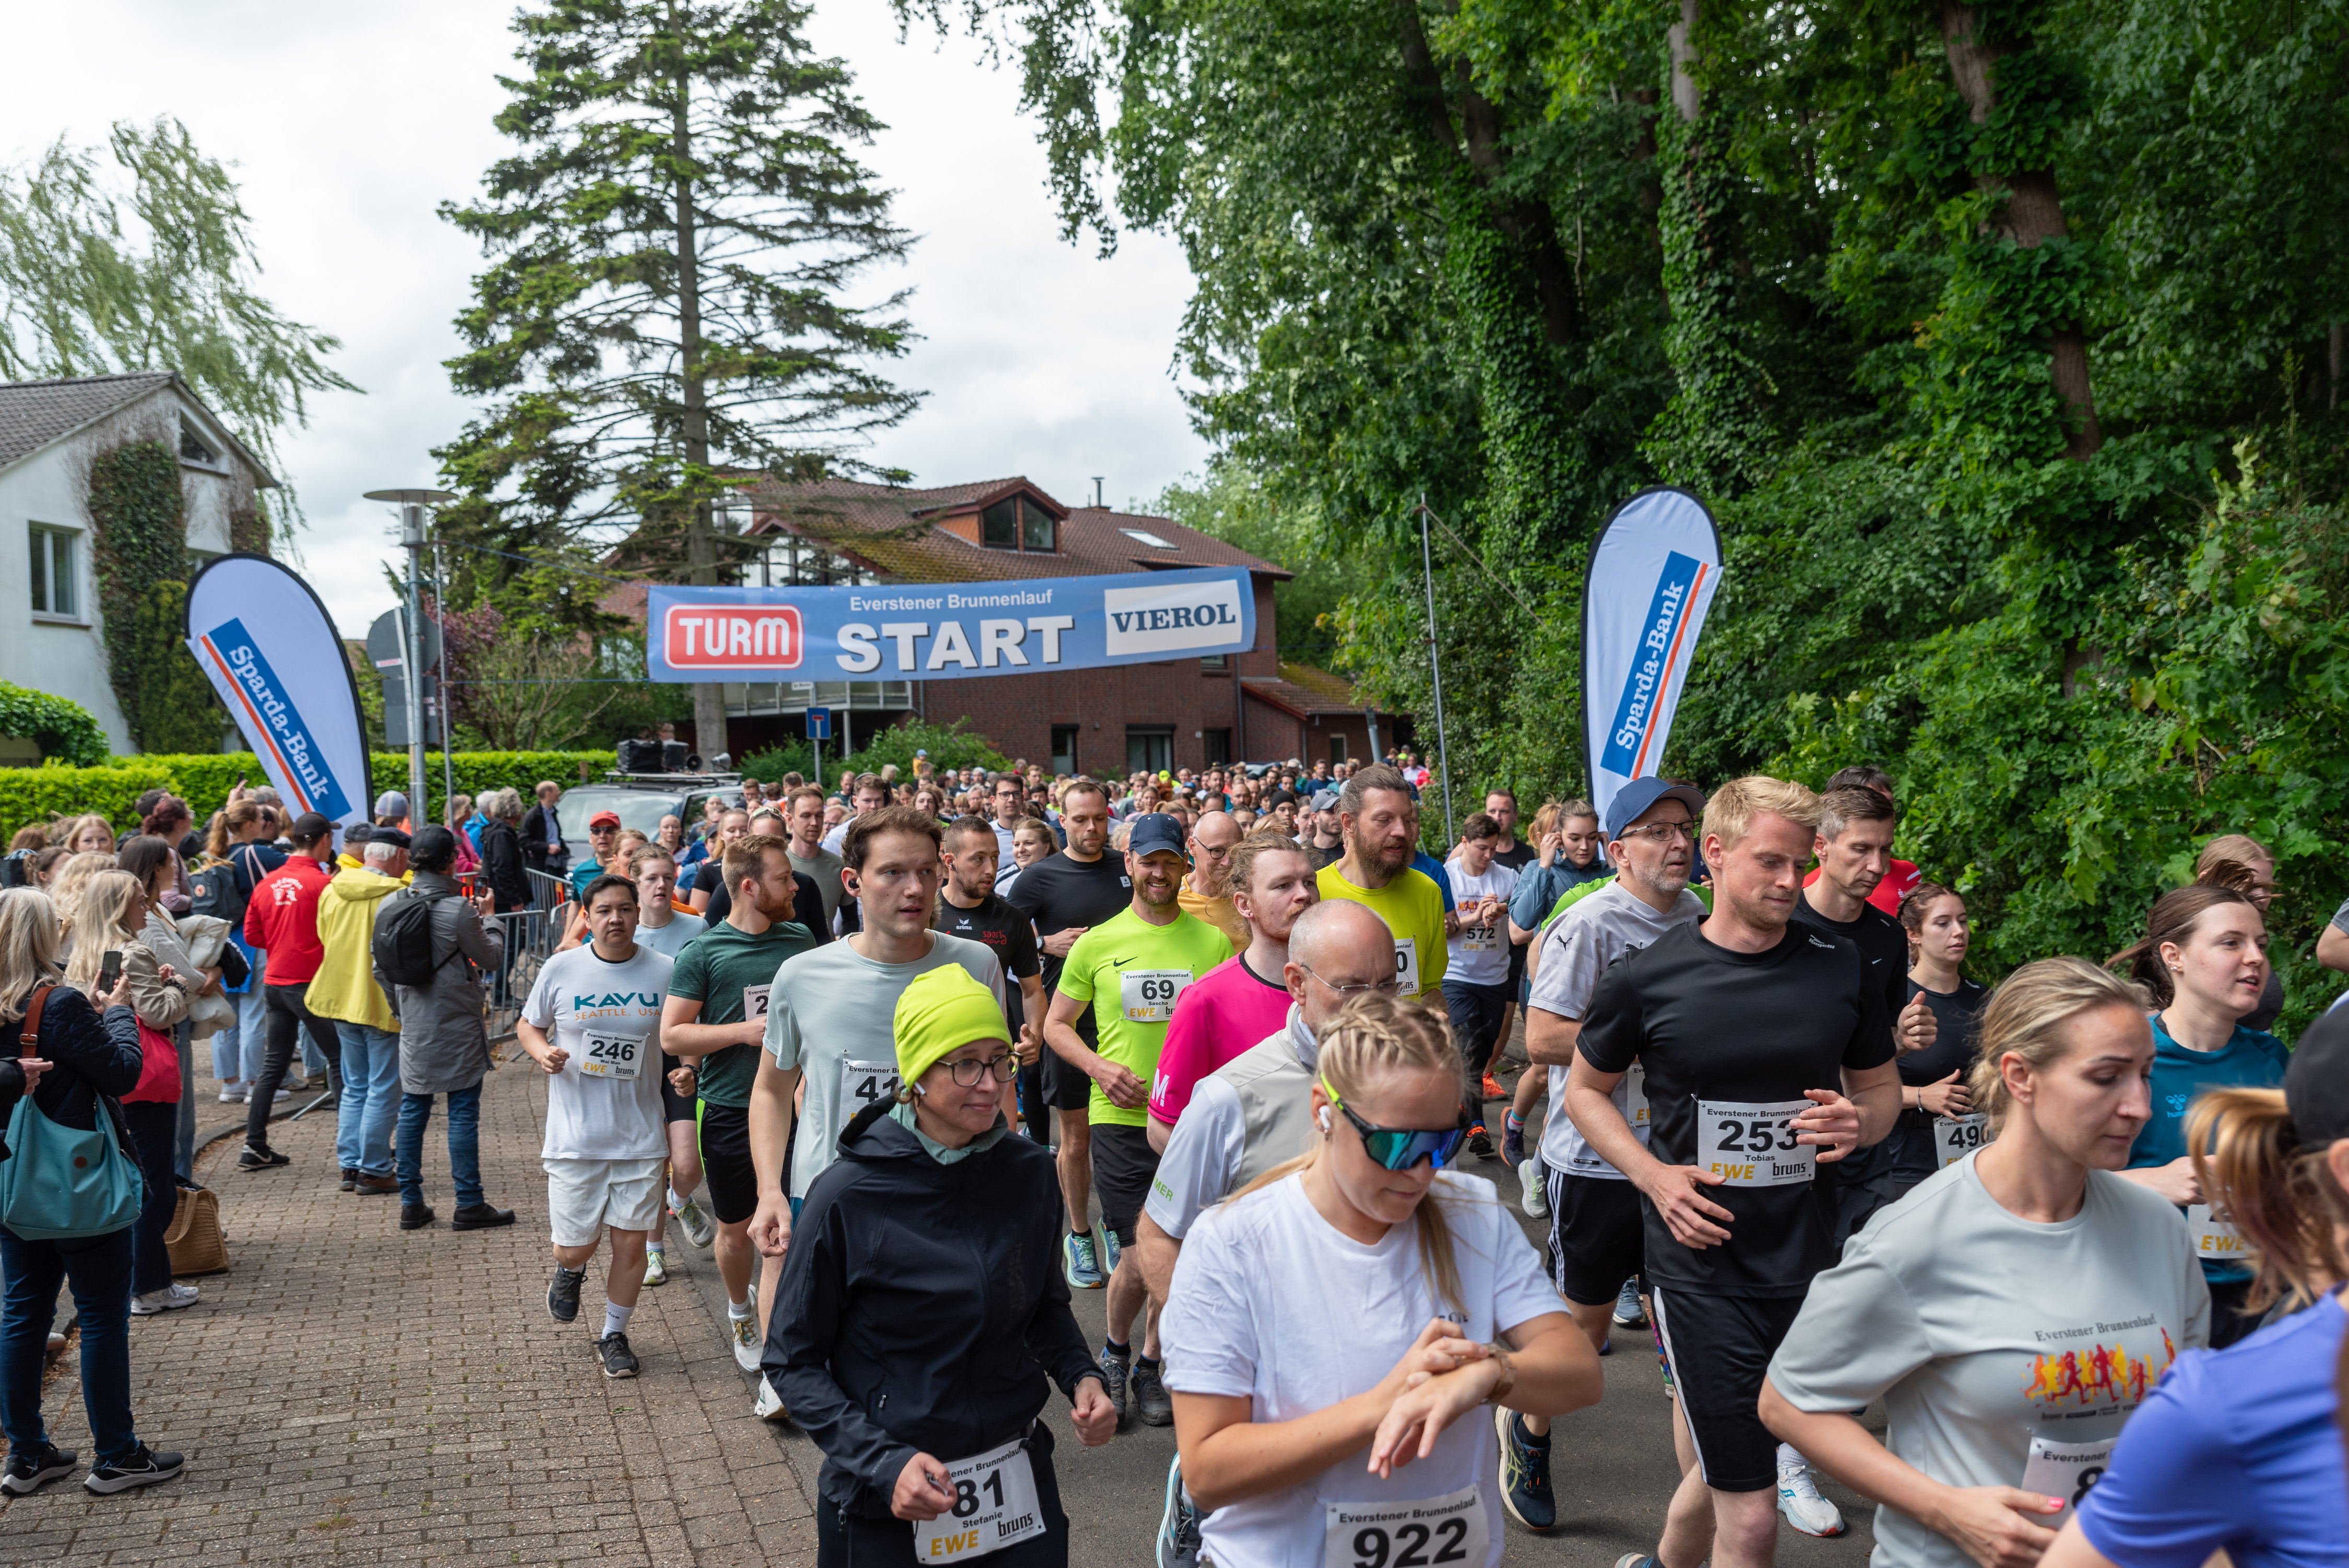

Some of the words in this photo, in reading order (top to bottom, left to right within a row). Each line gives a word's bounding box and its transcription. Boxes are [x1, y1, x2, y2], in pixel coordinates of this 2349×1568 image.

[850, 596, 943, 611] Everstener
[947, 589, 1053, 609] Brunnenlauf
[1110, 603, 1237, 633] VIEROL
[679, 617, 790, 656] TURM
[836, 615, 1075, 674] START
[1616, 580, 1684, 751] Sparda-Bank
[228, 645, 329, 800] Sparda-Bank
[982, 930, 1003, 940] sport
[1466, 927, 1495, 940] 572
[1809, 938, 1835, 949] Rogelli
[1141, 979, 1174, 1000] 69
[574, 992, 659, 1011] KAVU
[1130, 1007, 1156, 1017] EWE
[575, 1008, 631, 1020] SEATTLE,
[638, 1008, 661, 1016] USA
[589, 1040, 635, 1061] 246
[584, 1062, 607, 1073] EWE
[615, 1066, 635, 1075] bruns
[1707, 1109, 1758, 1117] Everstener
[1716, 1119, 1800, 1152] 253
[1711, 1162, 1755, 1180] EWE
[1773, 1162, 1806, 1176] bruns
[1154, 1174, 1173, 1202] MER
[2201, 1235, 2245, 1251] EWE
[2034, 1326, 2094, 1341] Everstener
[2095, 1313, 2157, 1333] Brunnenlauf
[976, 1446, 1022, 1471] Brunnenlauf
[2043, 1451, 2107, 1462] Everstener
[951, 1468, 1004, 1518] 81
[1339, 1510, 1409, 1523] Everstener
[1412, 1494, 1476, 1518] Brunnenlauf
[963, 1511, 1003, 1528] Stefanie
[998, 1512, 1033, 1537] bruns
[931, 1529, 979, 1557] EWE
[1353, 1516, 1467, 1568] 922
